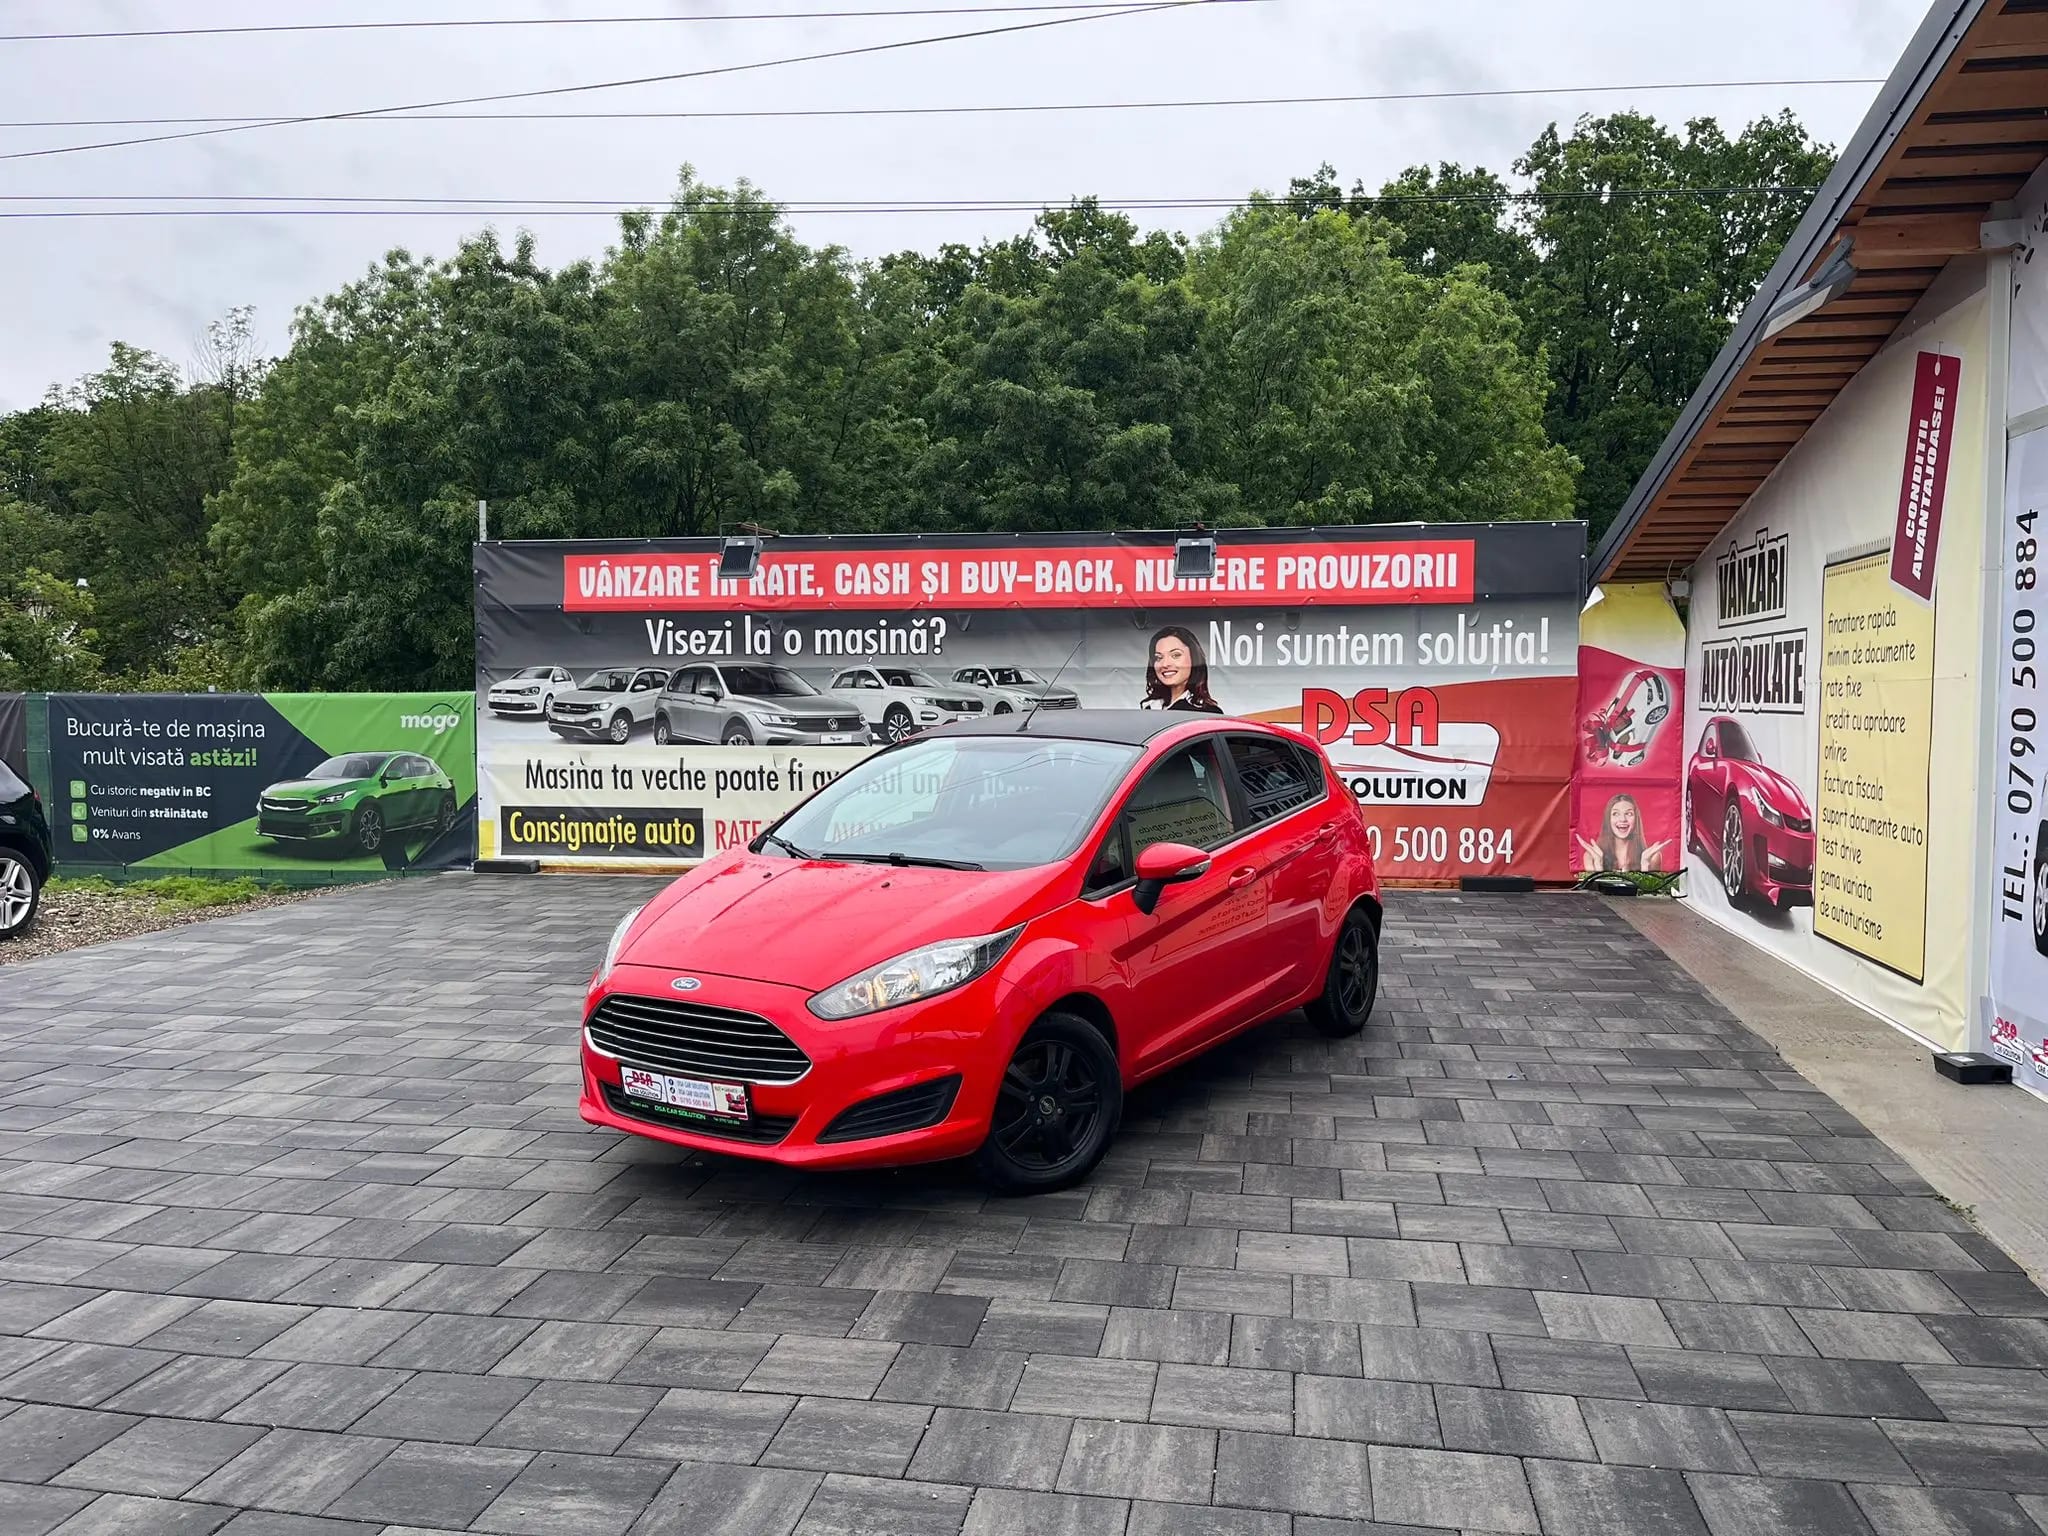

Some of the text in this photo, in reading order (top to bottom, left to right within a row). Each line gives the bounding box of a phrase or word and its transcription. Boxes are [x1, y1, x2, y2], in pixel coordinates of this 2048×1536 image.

[1905, 419, 1929, 539] CONDITII
[1912, 385, 1946, 581] AVANTAJOASE!
[2015, 508, 2039, 592] 884
[579, 560, 700, 598] VÂNZARE
[749, 563, 824, 598] RATE,
[835, 562, 910, 596] CASH
[921, 561, 949, 602] ȘI
[961, 559, 1123, 595] BUY-BACK,
[1276, 553, 1457, 591] PROVIZORII
[1719, 539, 1785, 620] VÂNZĂRI
[645, 618, 732, 655] Visezi
[744, 614, 771, 655] la
[783, 628, 802, 655] o
[1828, 603, 1896, 637] finantare rapida
[1209, 613, 1550, 675] Noi suntem soluția!
[1827, 639, 1916, 666] minim de documente
[2011, 608, 2036, 689] 500
[1701, 639, 1804, 705] AUTO RULATE
[1825, 675, 1862, 698] rate fixe
[67, 717, 265, 742] Bucură-te de mașina
[400, 714, 460, 735] mogo
[1302, 686, 1440, 746] DSA
[1825, 707, 1906, 739] credit cu aprobare
[83, 747, 257, 767] mult visată astăzi!
[1825, 739, 1847, 762] online
[2007, 707, 2037, 815] 0790
[90, 784, 212, 799] Cu istoric negativ in BC
[611, 764, 633, 790] ta
[641, 757, 706, 791] veche
[715, 764, 779, 799] poate
[787, 757, 803, 792] fi
[1824, 769, 1884, 801] factura fiscala
[90, 806, 209, 819] Venituri din străinătate
[509, 811, 696, 851] Consignație auto
[1822, 806, 1923, 846] suport documente auto
[92, 828, 142, 840] 0% Avans
[1393, 826, 1448, 863] 500
[1458, 827, 1514, 865] 884
[1822, 834, 1862, 864] test drive
[1820, 869, 1872, 902] gama variata
[1820, 895, 1882, 941] de autoturisme
[632, 1070, 653, 1086] DSA
